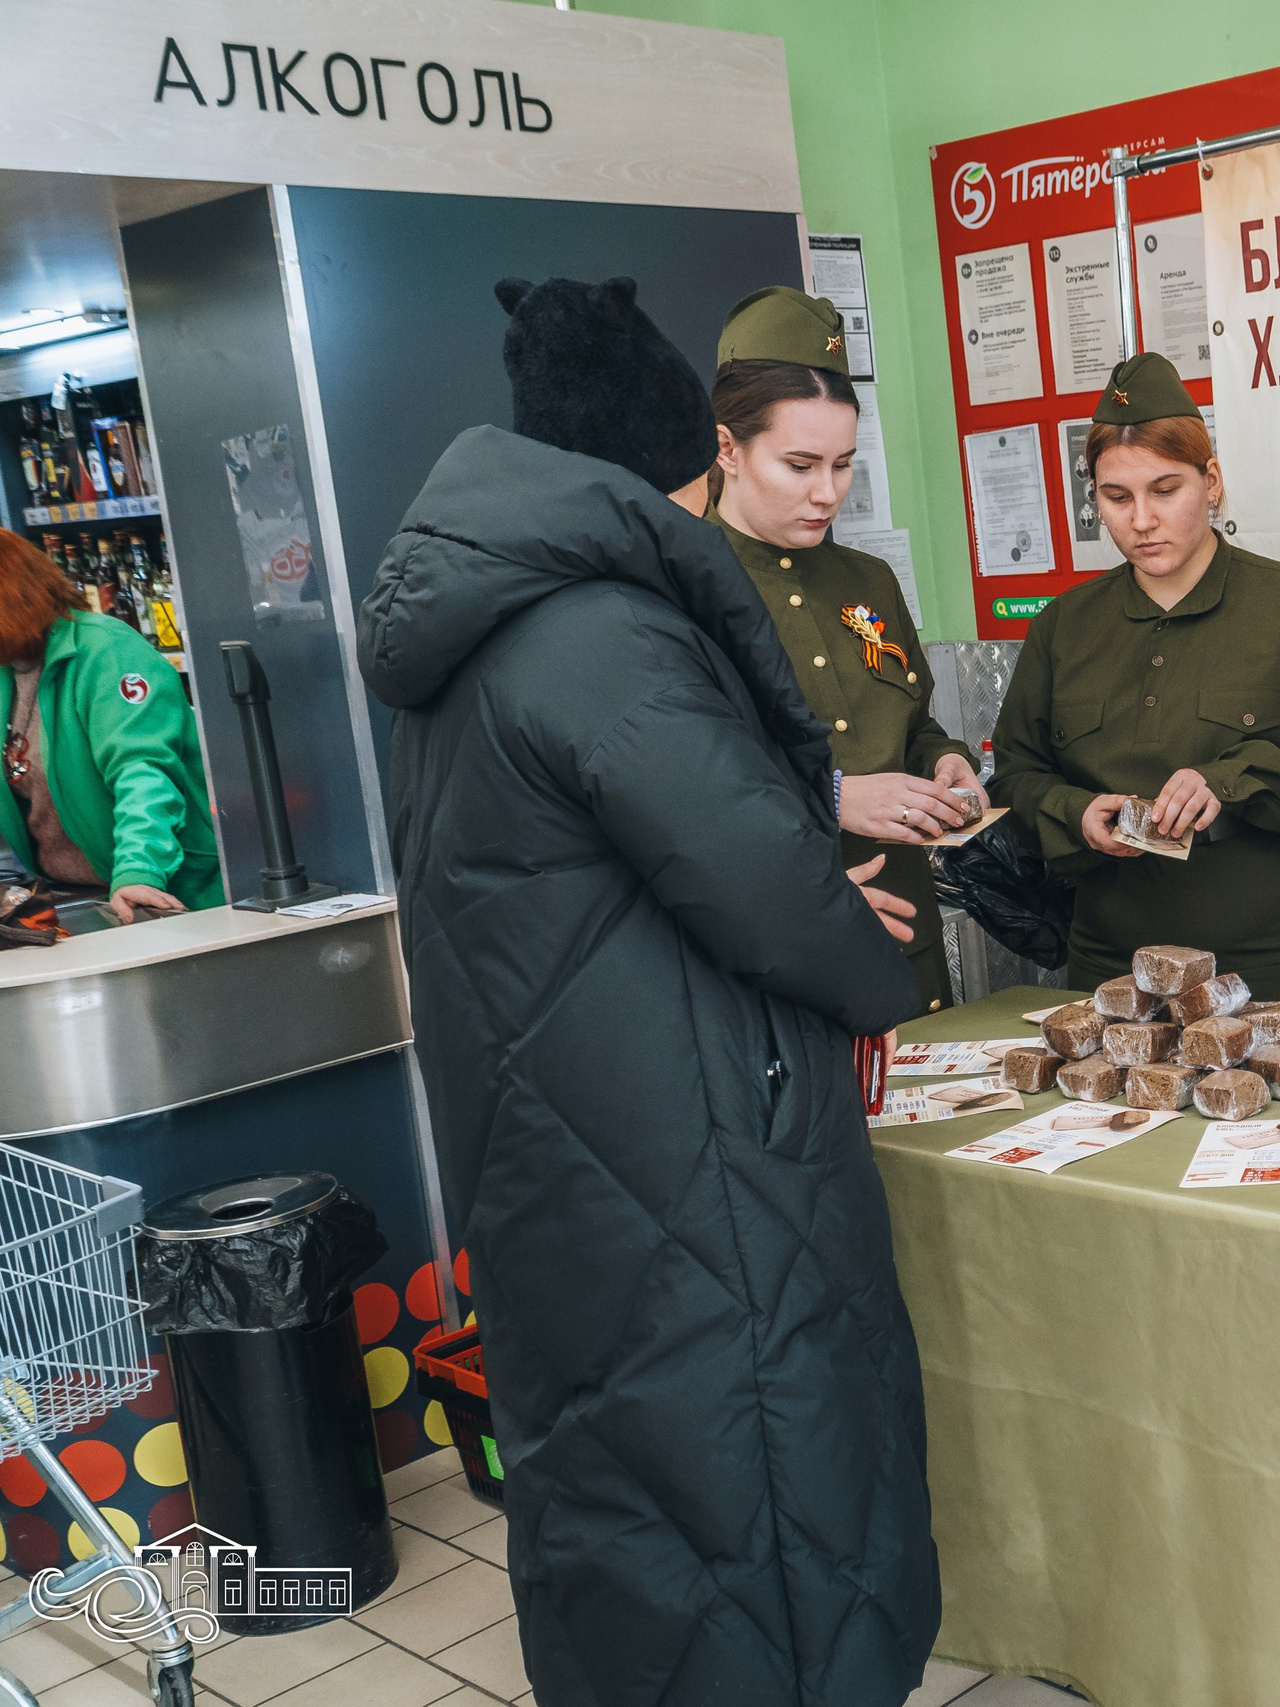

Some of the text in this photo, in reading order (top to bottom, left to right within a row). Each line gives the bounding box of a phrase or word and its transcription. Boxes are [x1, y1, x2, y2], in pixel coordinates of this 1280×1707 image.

[154, 37, 553, 133] АЛКОГОЛЬ
[974, 254, 1014, 268] Запрещена
[1065, 261, 1110, 274] Экстренные
[975, 265, 1007, 277] продажа
[1160, 270, 1187, 280] Аренда
[1065, 272, 1095, 284] службы
[981, 327, 1025, 340] Вне очереди
[1010, 600, 1048, 613] www.5
